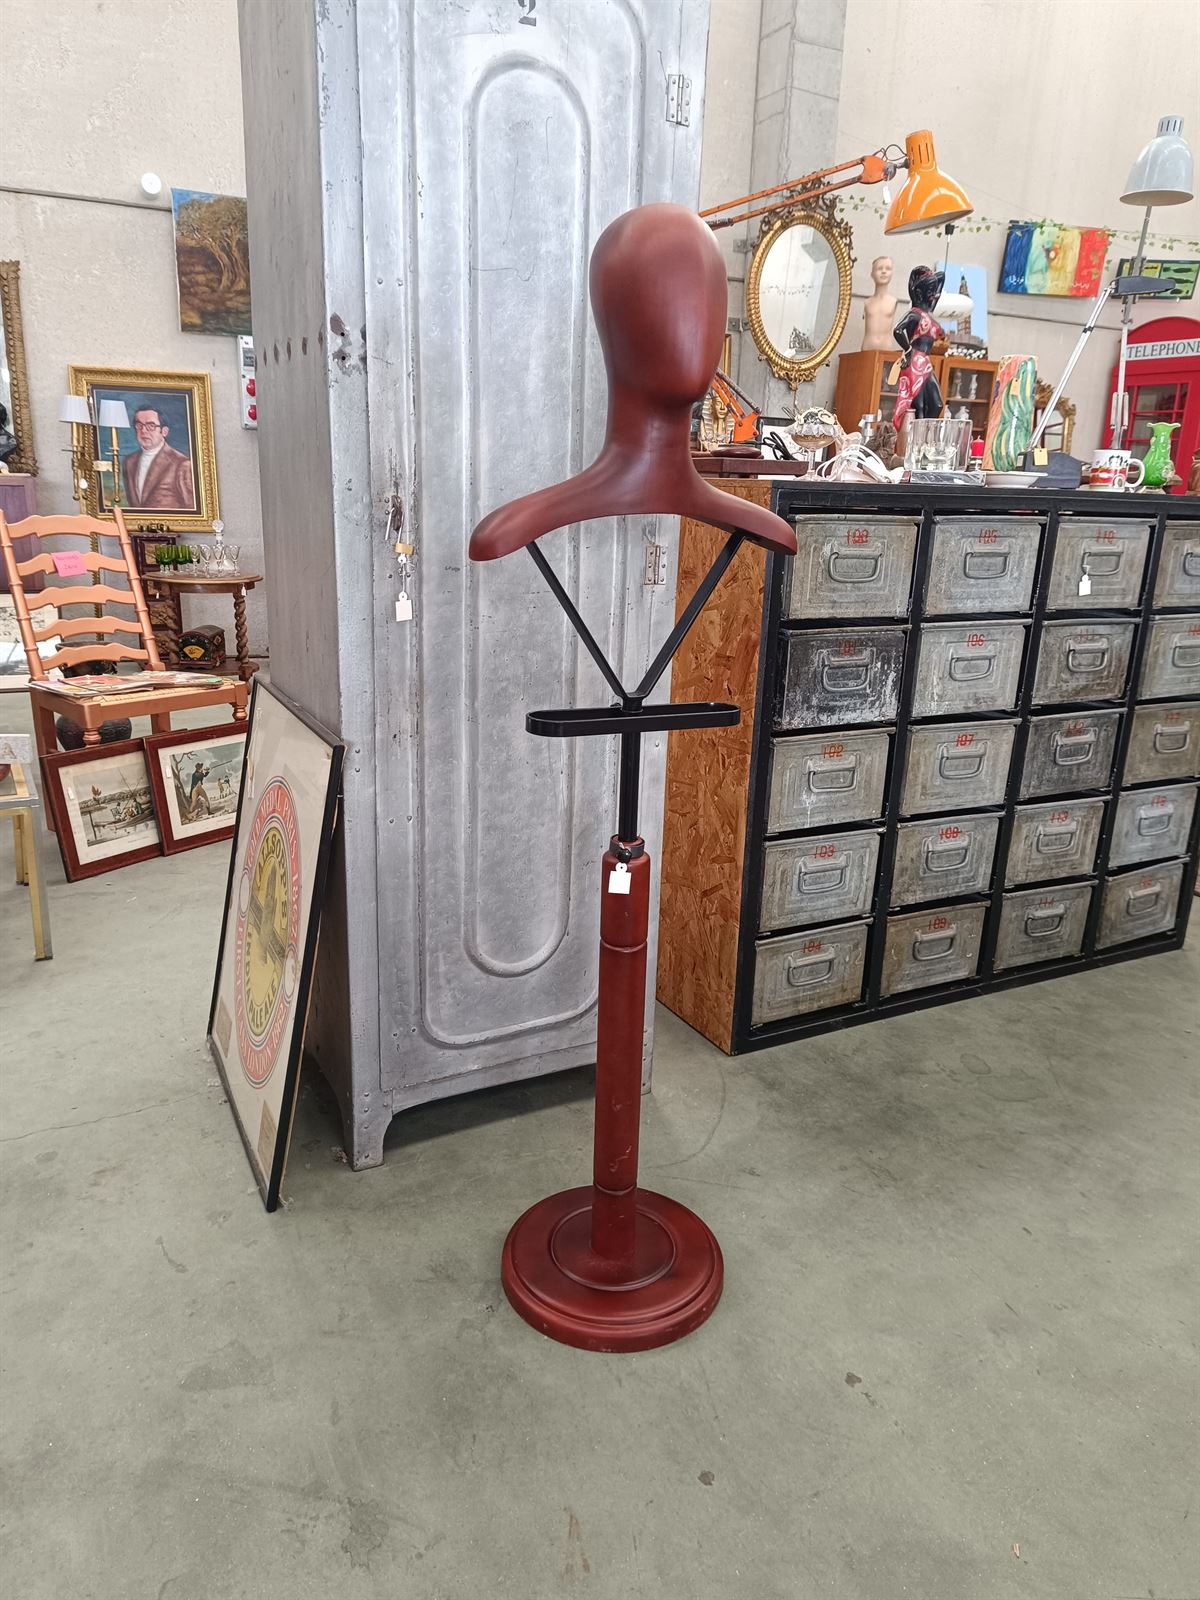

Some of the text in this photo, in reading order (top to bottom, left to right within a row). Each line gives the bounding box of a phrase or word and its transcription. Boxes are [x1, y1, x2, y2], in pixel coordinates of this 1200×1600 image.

[967, 633, 985, 647] 106
[956, 733, 975, 747] 107
[823, 744, 844, 758] 102
[281, 795, 296, 859] PARIS
[814, 844, 836, 858] 103
[248, 1000, 263, 1029] PALE
[263, 978, 277, 1022] ALE
